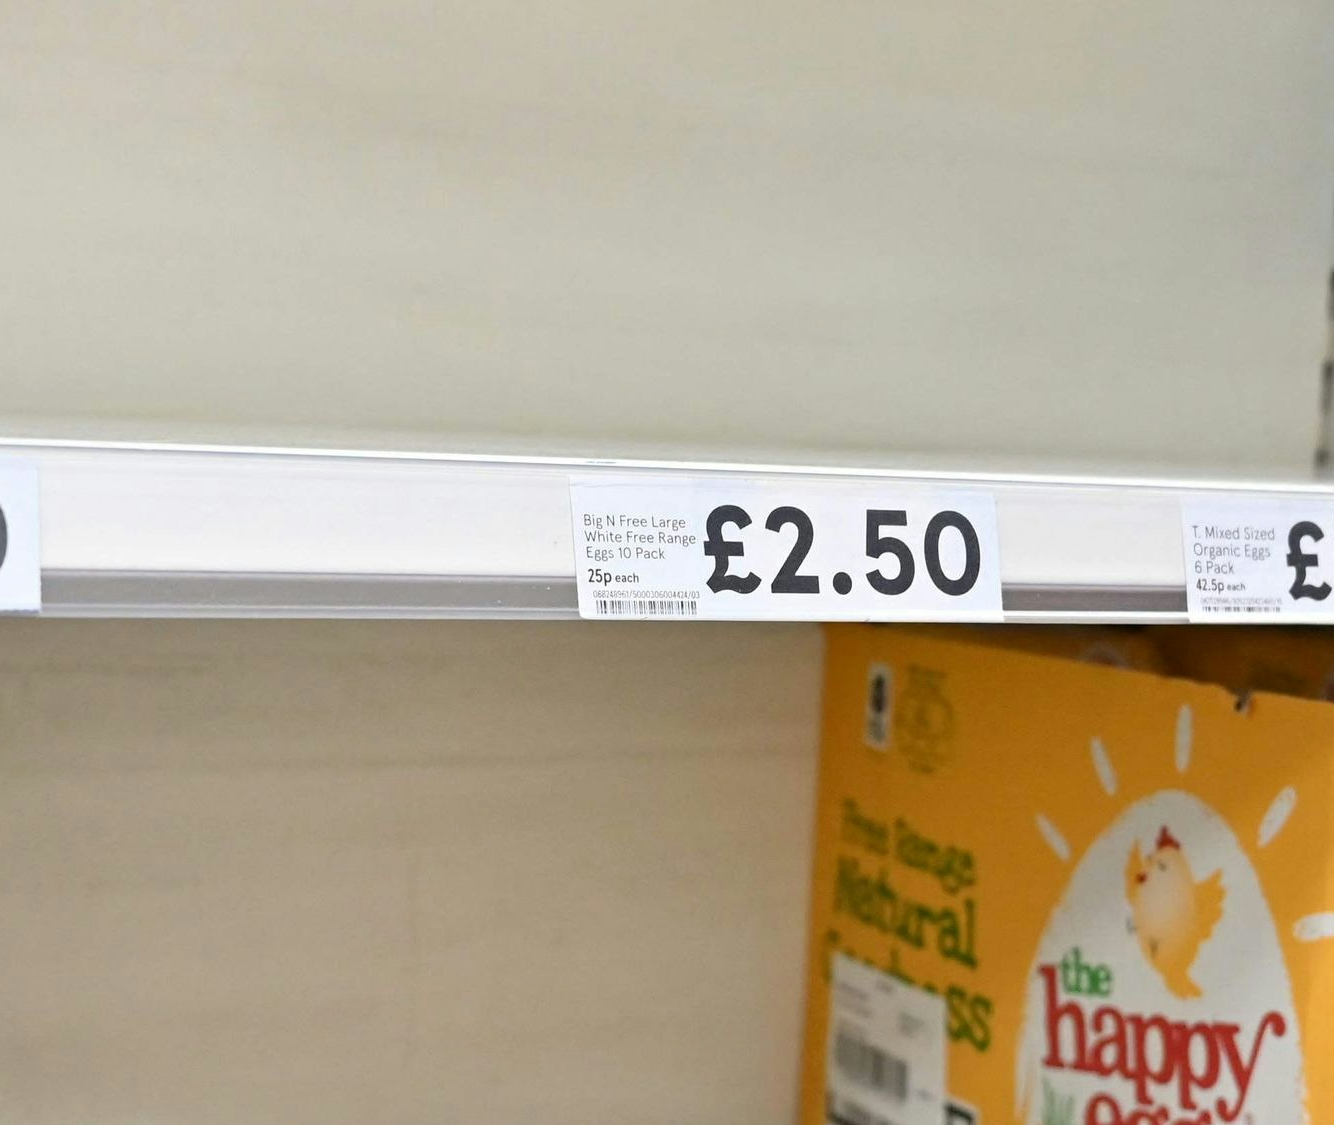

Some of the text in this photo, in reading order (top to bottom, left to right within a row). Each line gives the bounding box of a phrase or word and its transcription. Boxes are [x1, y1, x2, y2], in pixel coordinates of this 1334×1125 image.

[583, 513, 686, 532] Big N Free Large
[584, 530, 697, 548] White Free Range
[1204, 526, 1240, 540] Mixed
[1243, 527, 1276, 541] Sized
[586, 546, 666, 562] Eggs 10 Pack
[703, 504, 982, 597] £2.50
[1193, 542, 1271, 561] Organic Eggs
[1194, 560, 1235, 575] 6 Pack
[588, 569, 640, 587] 25p each
[1196, 578, 1246, 595] 42.5p each
[832, 853, 979, 970] Natural
[1058, 946, 1114, 997] the
[1037, 963, 1287, 1124] happy
